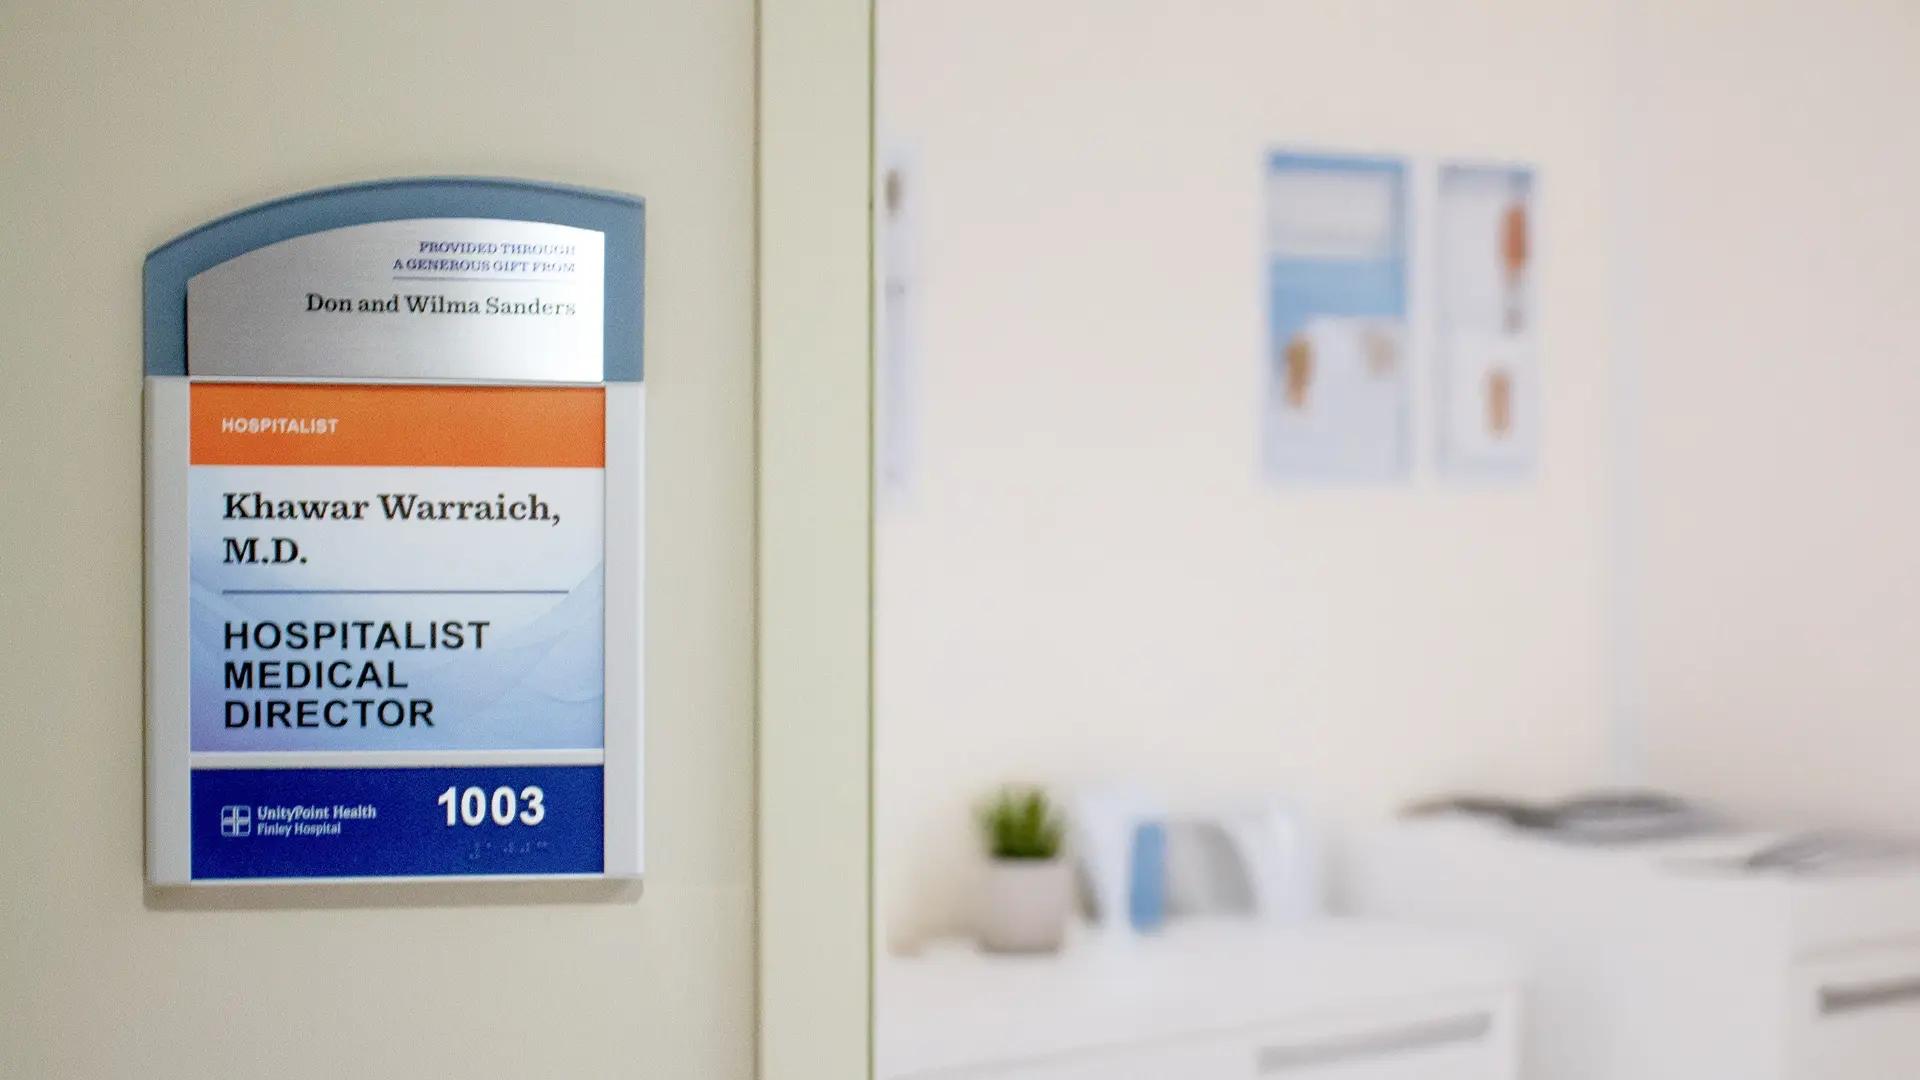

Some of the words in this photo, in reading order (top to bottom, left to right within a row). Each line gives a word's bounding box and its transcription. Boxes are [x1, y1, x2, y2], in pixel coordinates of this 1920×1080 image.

[419, 241, 497, 255] PROVIDED
[500, 242, 576, 256] THROUGH
[393, 259, 404, 270] A
[406, 259, 491, 272] GENEROUS
[494, 260, 530, 272] GIFT
[532, 261, 576, 273] FROM
[305, 293, 353, 313] Don
[358, 294, 399, 314] and
[404, 295, 480, 315] Wilma
[486, 296, 576, 316] Sanders
[221, 418, 338, 434] HOSPITALIST
[222, 493, 369, 520] Khawar
[377, 494, 561, 526] Warraich,
[222, 537, 308, 564] M.D.
[224, 621, 490, 650] HOSPITALIST
[224, 661, 408, 689] MEDICAL
[224, 699, 434, 728] DIRECTOR
[257, 805, 330, 822] UnityPoint
[333, 805, 377, 820] Health
[437, 785, 546, 827] 1003
[257, 822, 291, 837] Finley
[294, 822, 341, 837] Hospital
